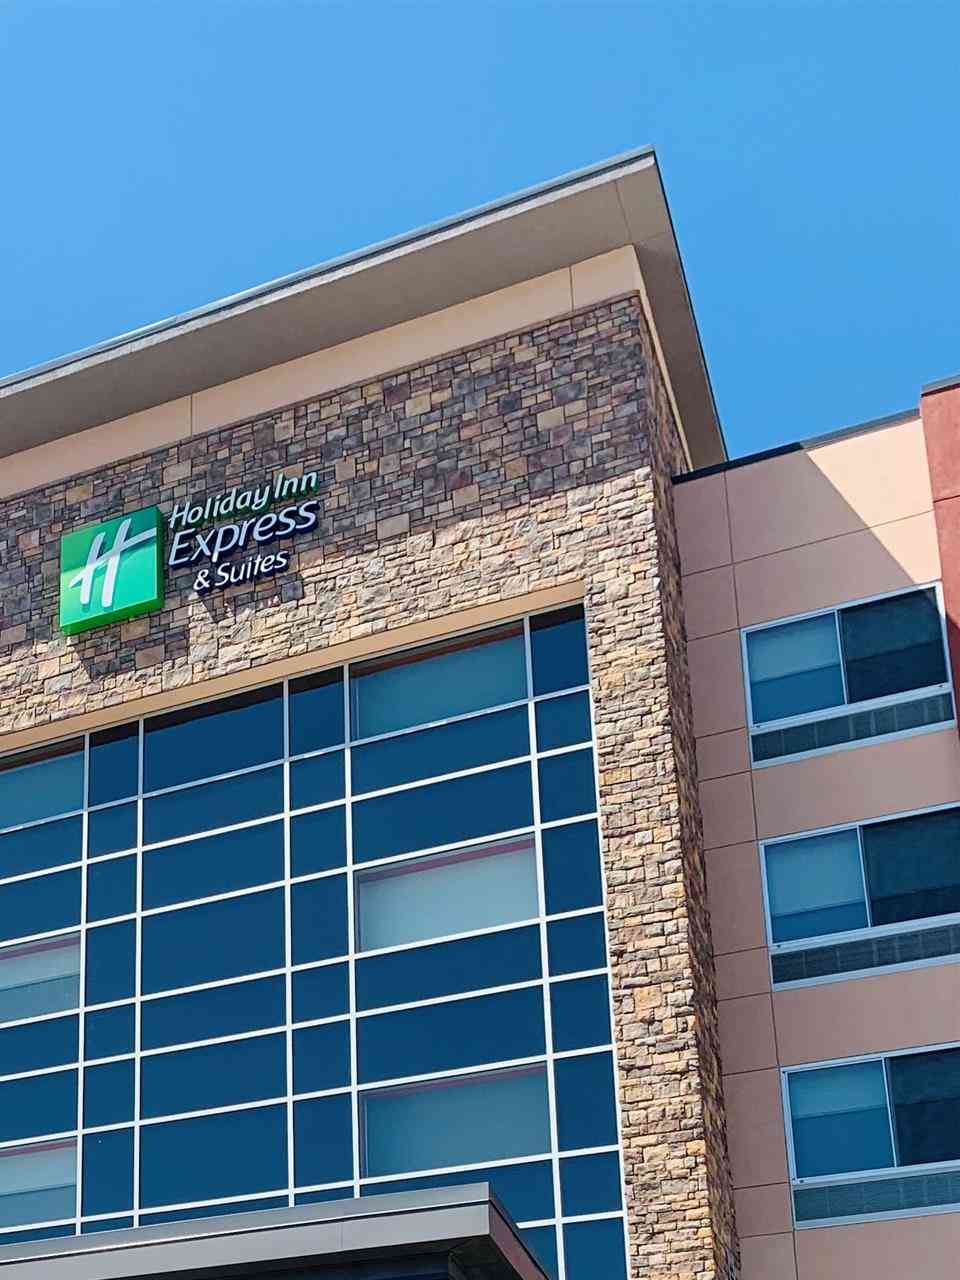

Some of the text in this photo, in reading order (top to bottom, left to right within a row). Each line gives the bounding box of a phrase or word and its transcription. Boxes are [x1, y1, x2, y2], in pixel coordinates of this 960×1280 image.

[168, 471, 318, 529] Holiday Inn
[168, 500, 319, 566] Express
[193, 550, 289, 591] & Suites
